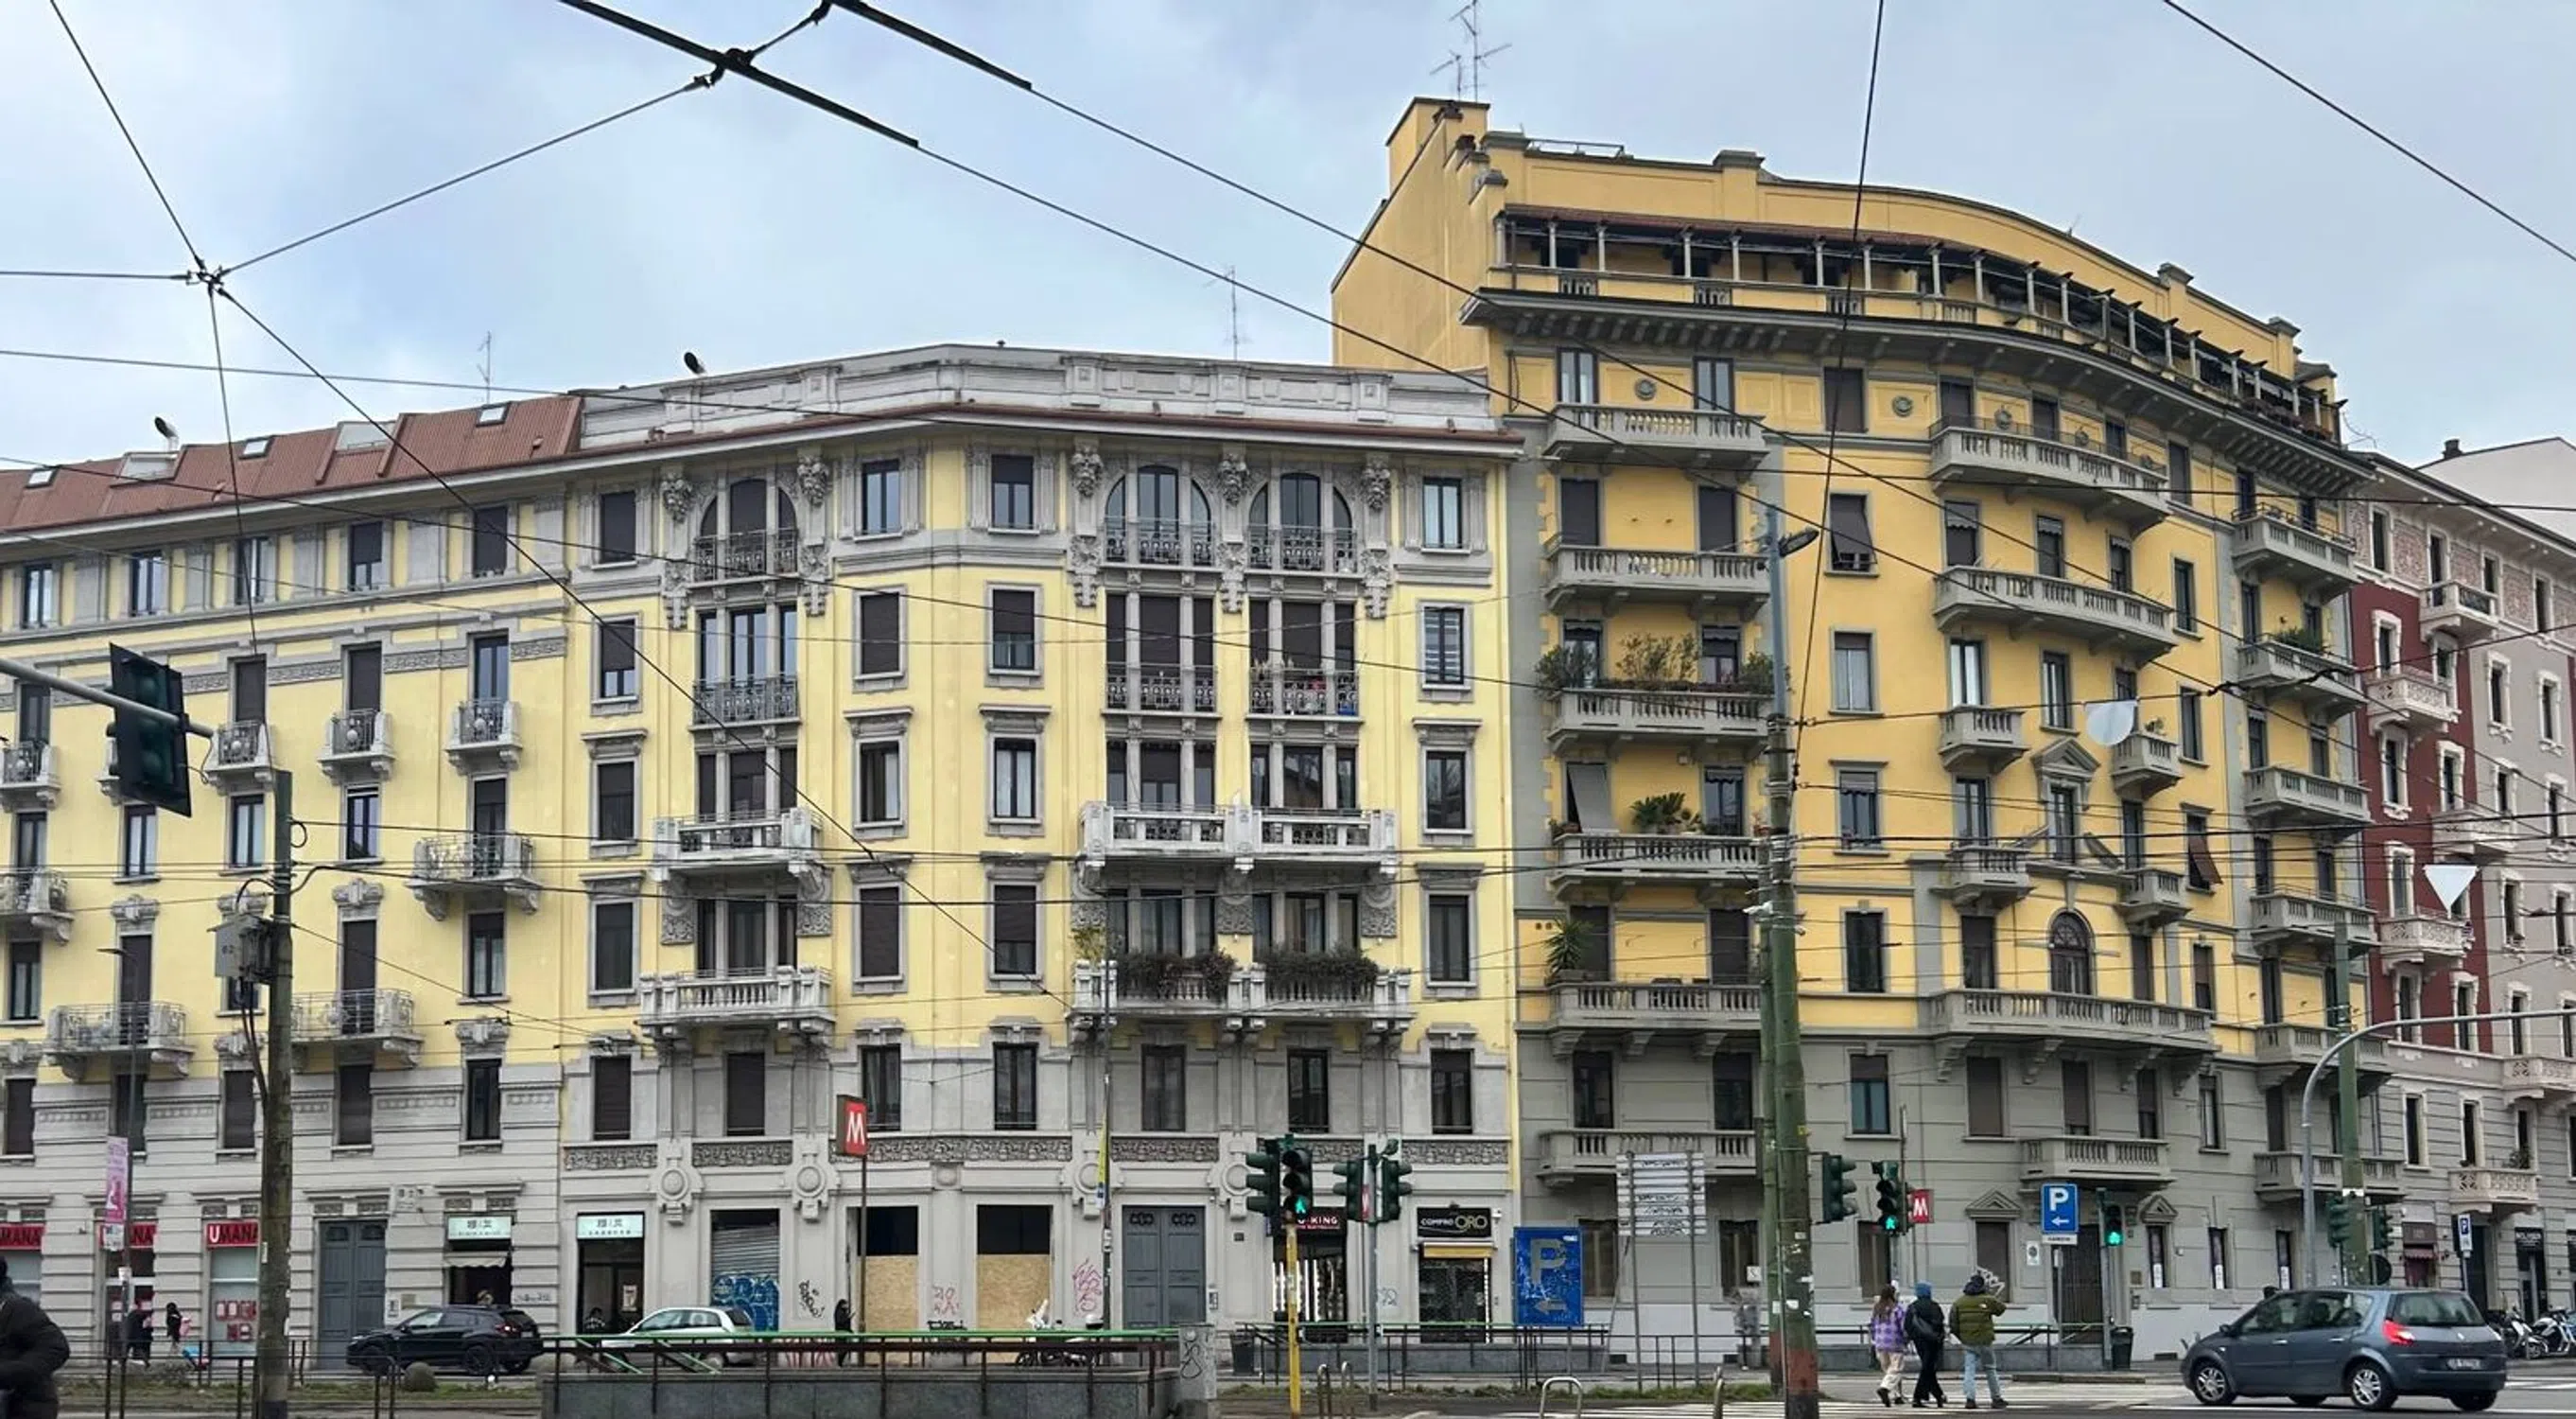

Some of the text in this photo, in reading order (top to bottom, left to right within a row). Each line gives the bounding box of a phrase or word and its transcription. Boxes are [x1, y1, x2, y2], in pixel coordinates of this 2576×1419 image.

[845, 1110, 865, 1146] M
[1913, 1198, 1928, 1217] M
[2048, 1187, 2069, 1211] P
[1420, 1215, 1488, 1230] COMPRO ORO
[1530, 1238, 1568, 1285] P
